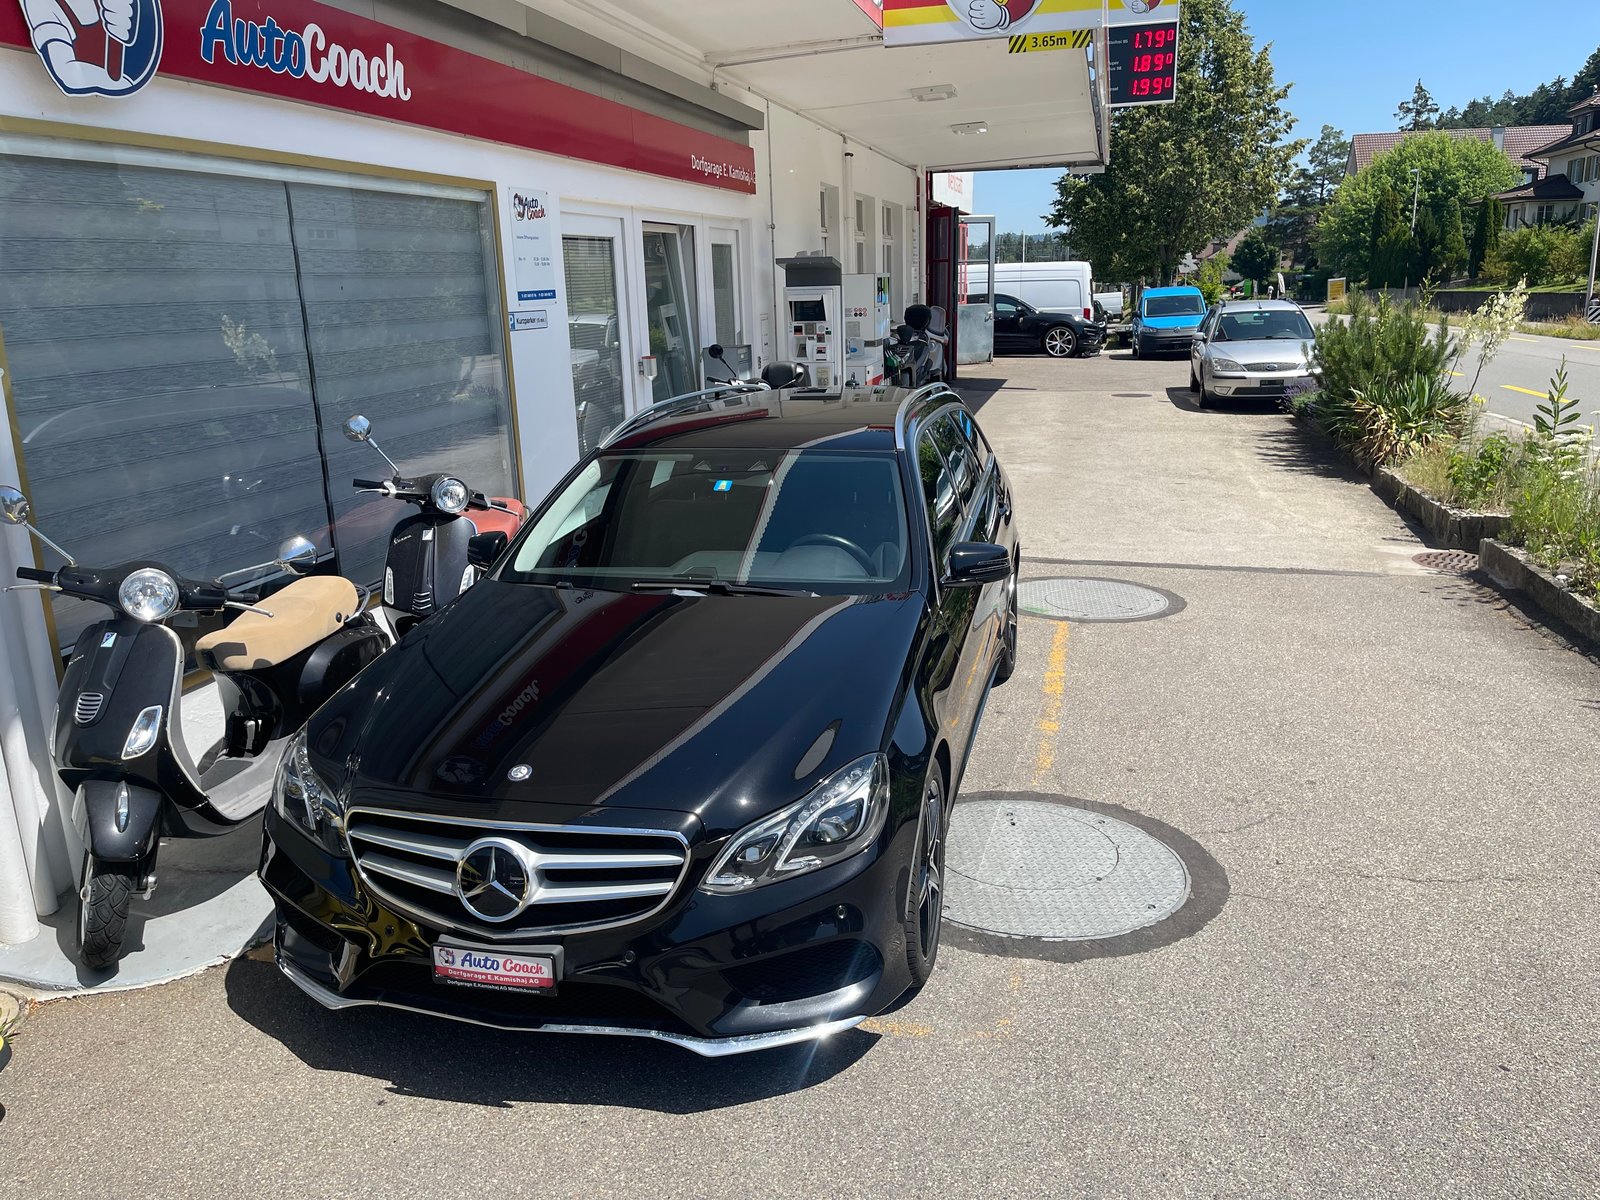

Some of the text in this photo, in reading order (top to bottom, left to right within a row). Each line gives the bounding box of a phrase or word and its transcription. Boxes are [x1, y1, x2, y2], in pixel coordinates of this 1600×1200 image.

[1031, 35, 1067, 48] 3.65m
[691, 154, 722, 179] Dorfgarage
[524, 196, 539, 208] Auto
[527, 205, 546, 220] Coach
[460, 951, 544, 975] Auto Coach
[448, 969, 486, 980] Dorfgarage
